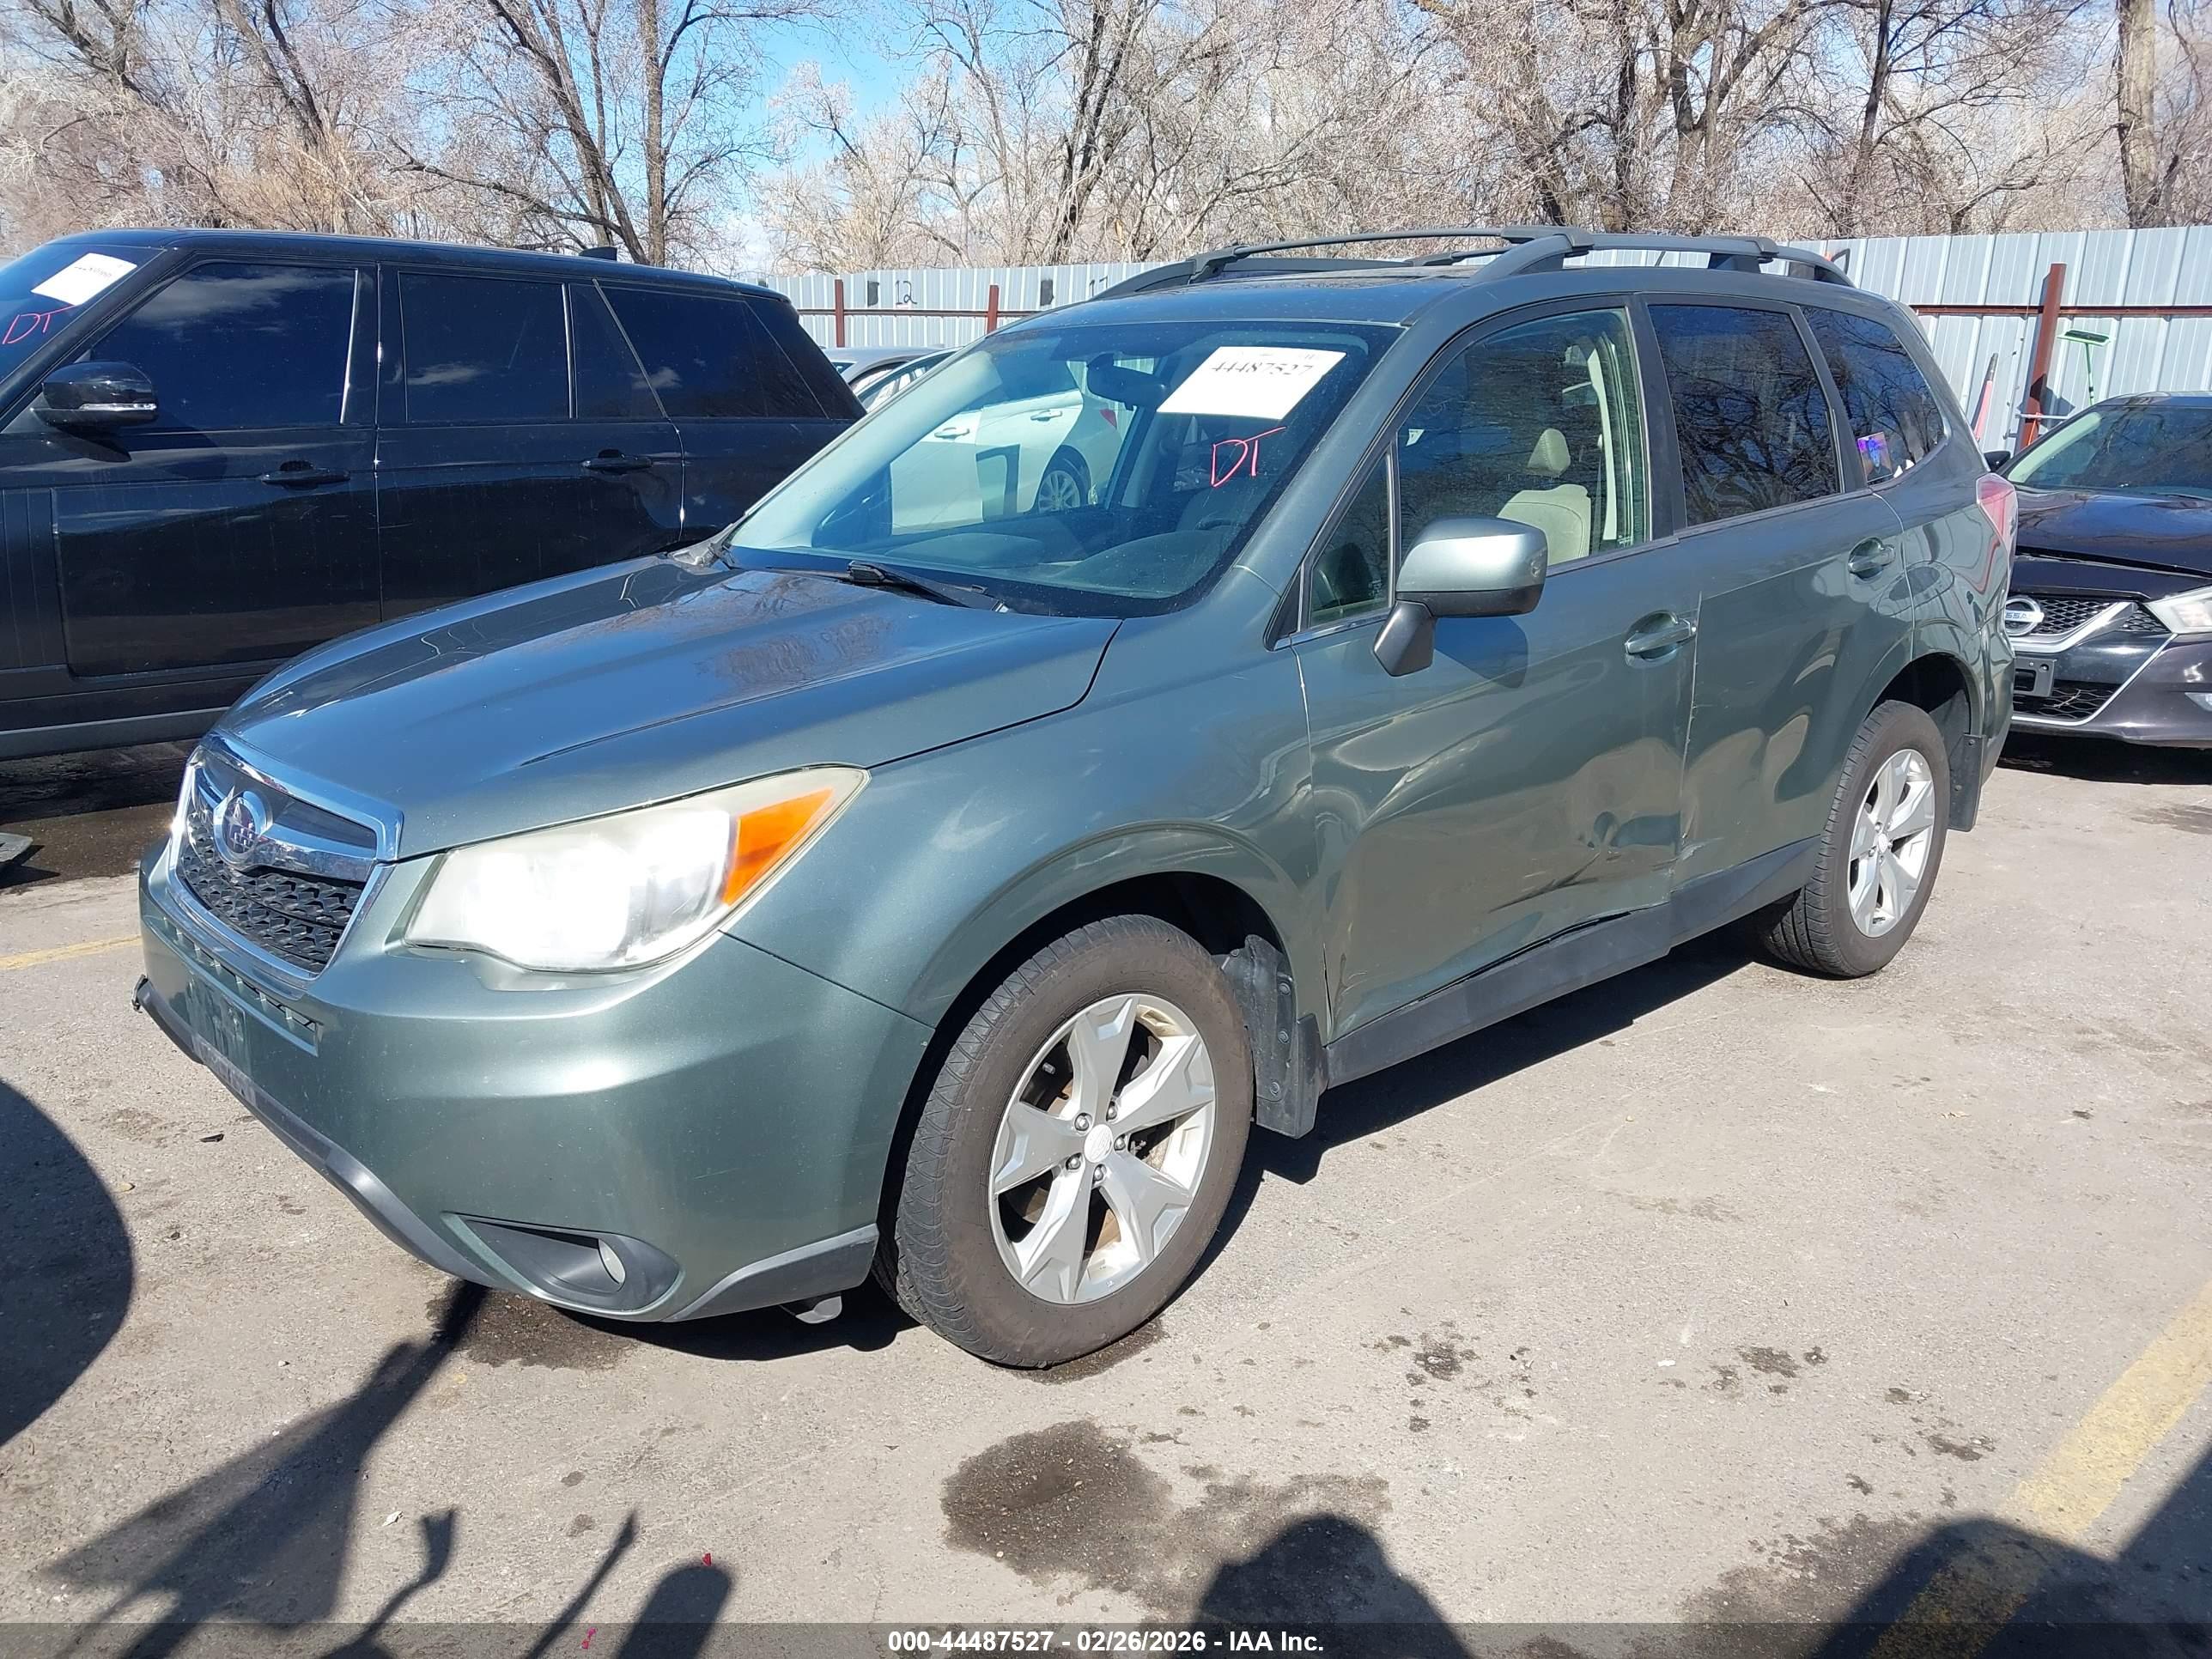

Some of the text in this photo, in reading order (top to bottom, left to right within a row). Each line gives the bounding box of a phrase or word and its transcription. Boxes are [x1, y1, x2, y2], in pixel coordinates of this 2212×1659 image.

[895, 280, 918, 305] 12
[2, 304, 76, 344] DT
[1211, 362, 1313, 375] 44487527
[1211, 426, 1286, 488] DT
